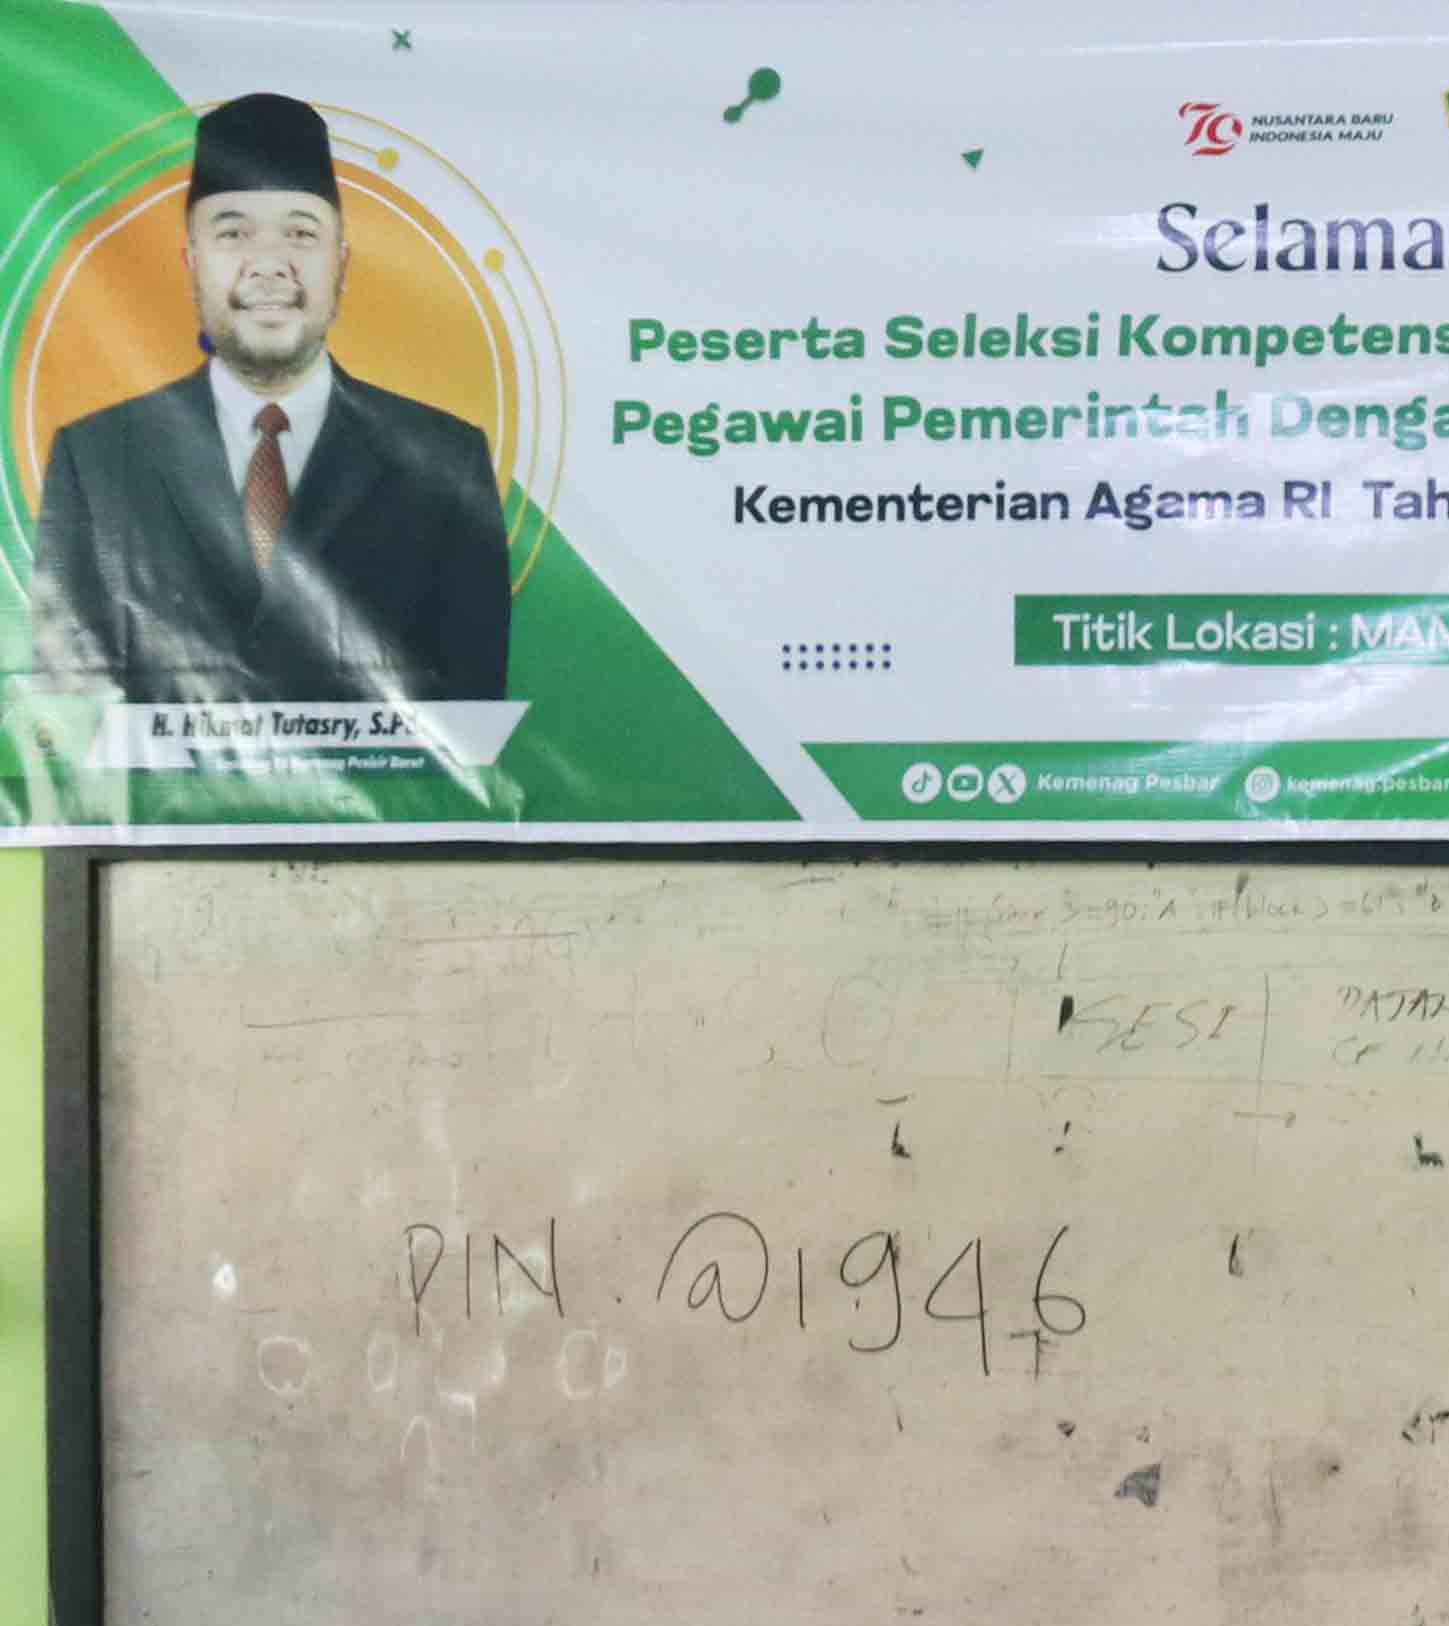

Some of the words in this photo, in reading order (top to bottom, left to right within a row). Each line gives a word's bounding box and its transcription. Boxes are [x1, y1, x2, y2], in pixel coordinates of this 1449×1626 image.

[1249, 129, 1333, 143] INDONESIA
[1338, 129, 1384, 142] MAJU
[1251, 114, 1346, 127] NUSANTARA
[1351, 112, 1394, 126] BARU
[628, 317, 865, 362] Peserta
[884, 312, 1099, 359] Seleksi
[612, 394, 863, 456] Pegawai
[883, 391, 1248, 443] Pemerintah
[733, 482, 1071, 526] Kementerian
[1085, 482, 1265, 531] Agama
[1283, 481, 1332, 519] RI
[1053, 612, 1150, 651] Titik
[1167, 612, 1316, 652] Lokasi
[271, 711, 360, 741] Tutasry,
[1037, 773, 1137, 794] Kemenag
[1144, 772, 1221, 792] Pesbar
[1071, 993, 1238, 1055] SESI
[656, 1212, 1086, 1376] @1946
